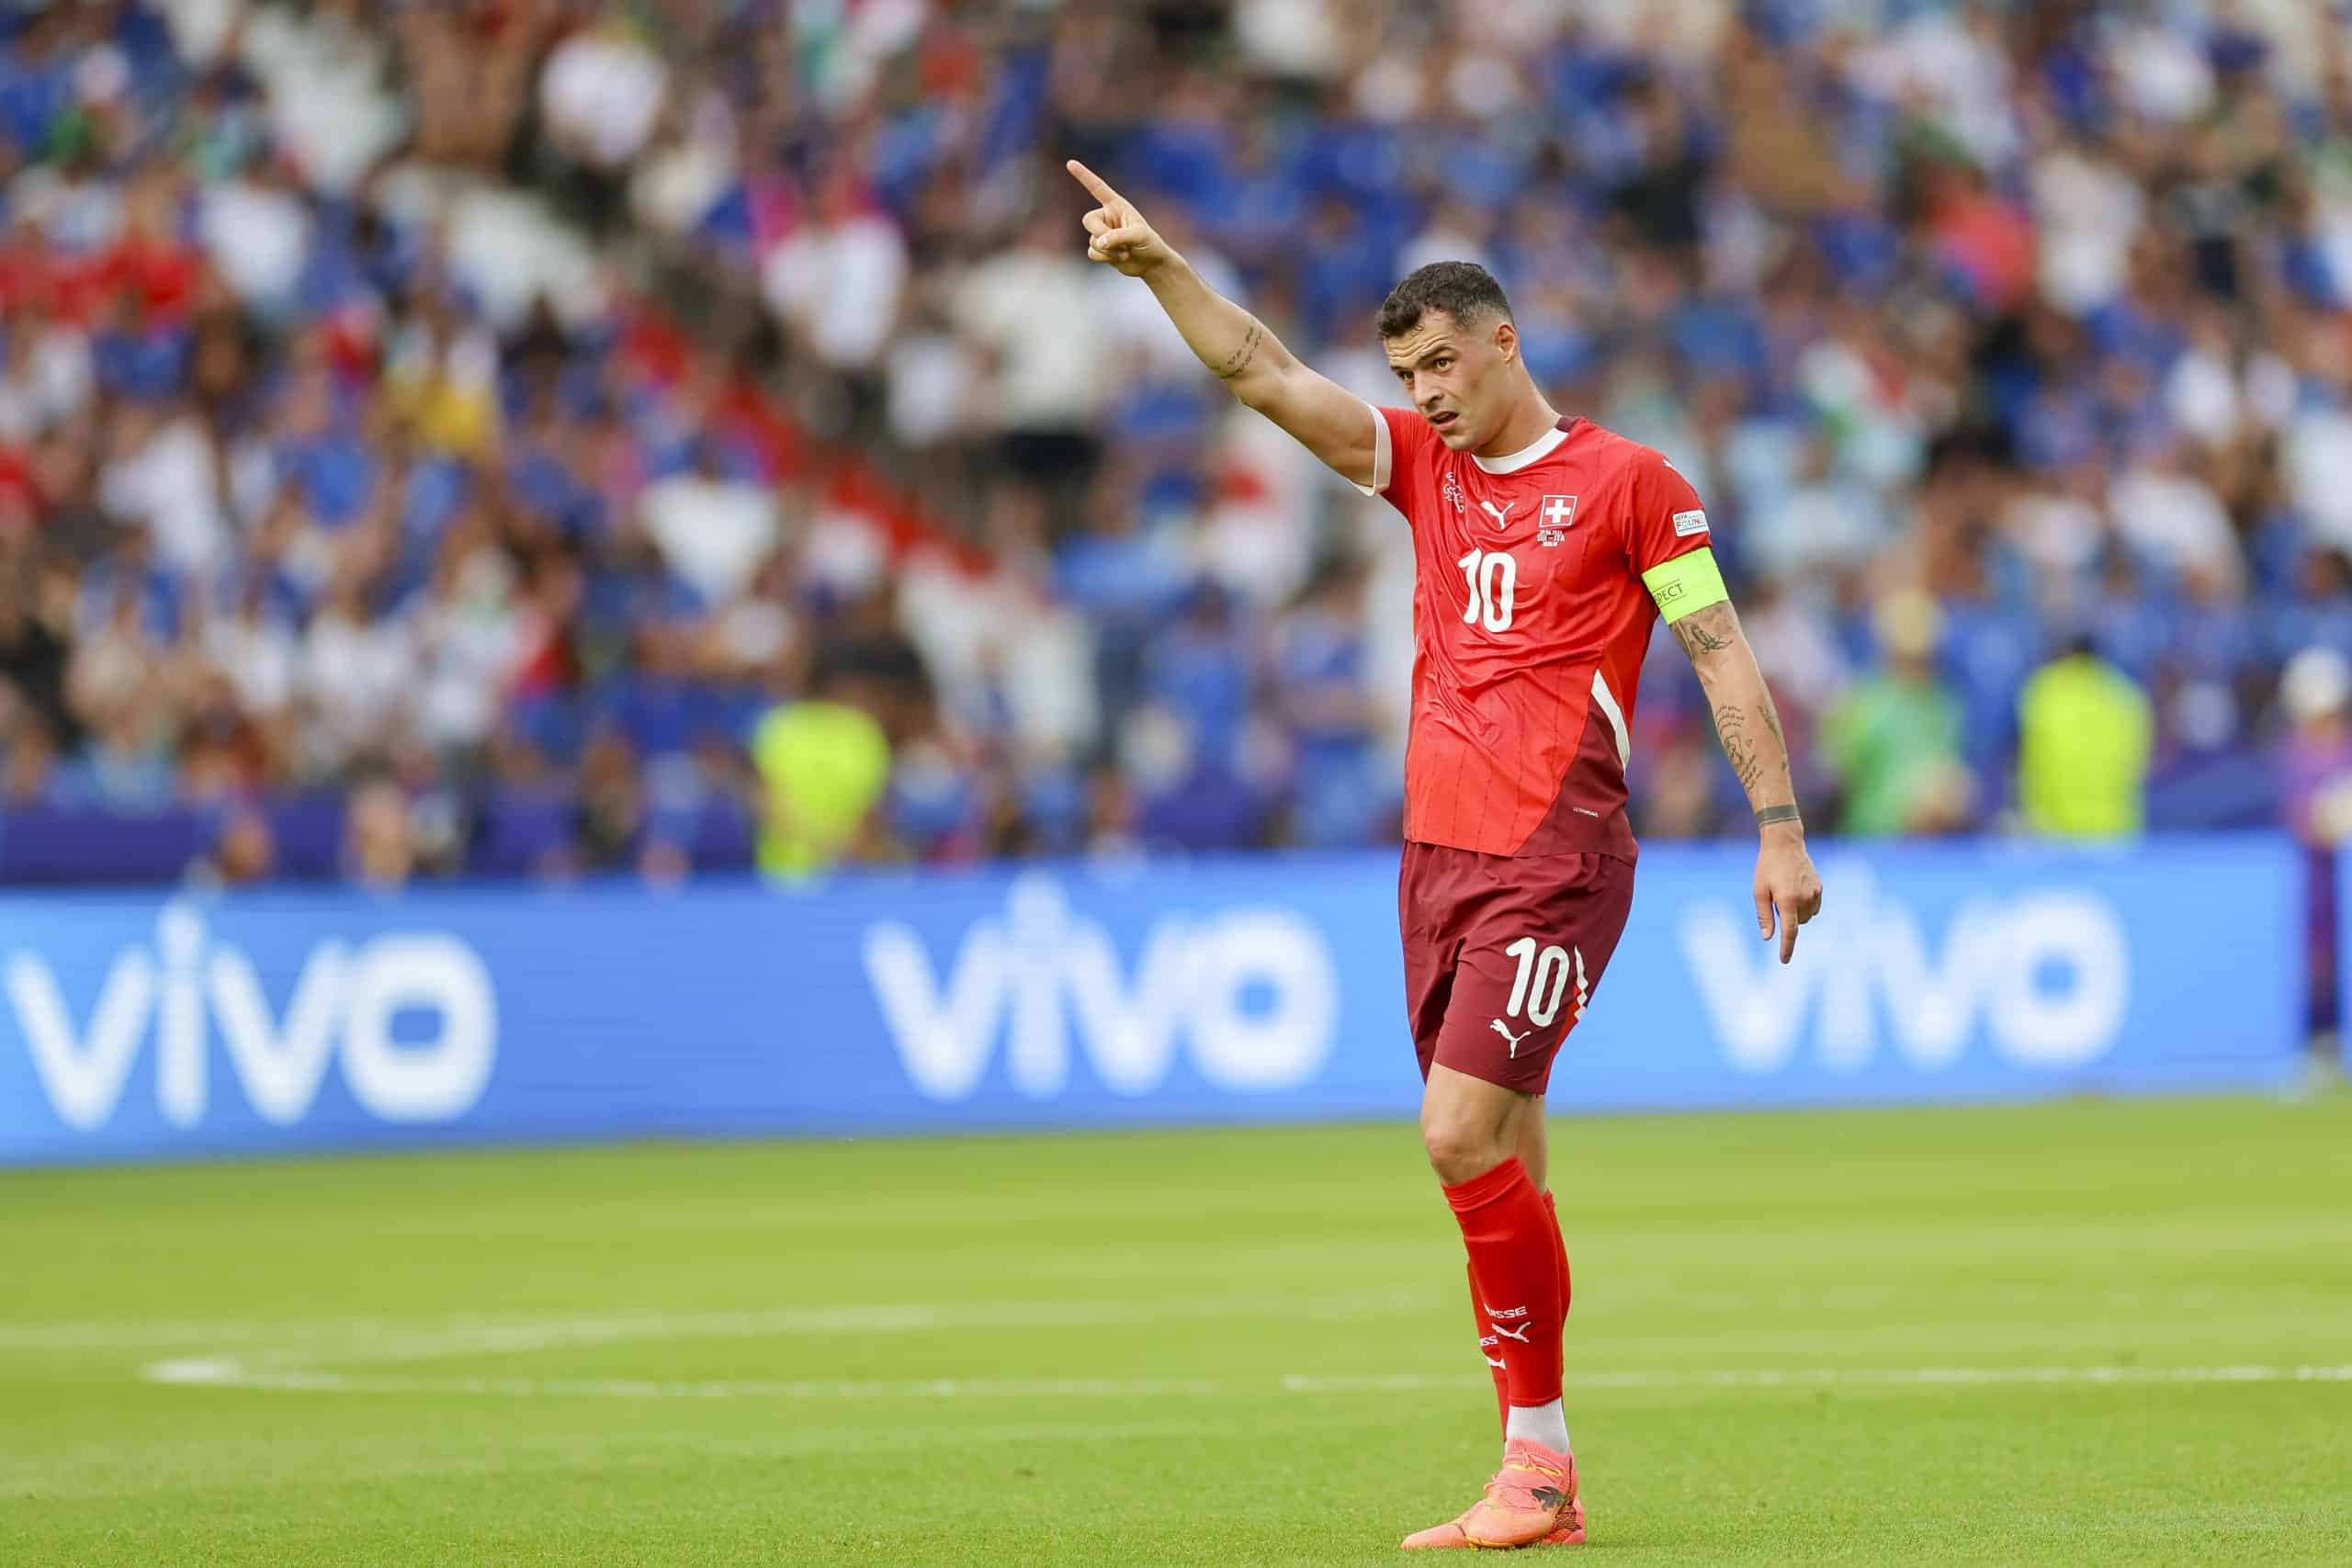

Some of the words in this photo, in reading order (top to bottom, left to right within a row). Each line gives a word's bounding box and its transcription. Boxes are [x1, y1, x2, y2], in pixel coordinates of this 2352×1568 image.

[1458, 547, 1516, 633] 10
[6, 897, 497, 1130] vivo
[861, 869, 1341, 1102] vivo
[1506, 937, 1570, 1027] 10
[1680, 856, 2132, 1074] vivo
